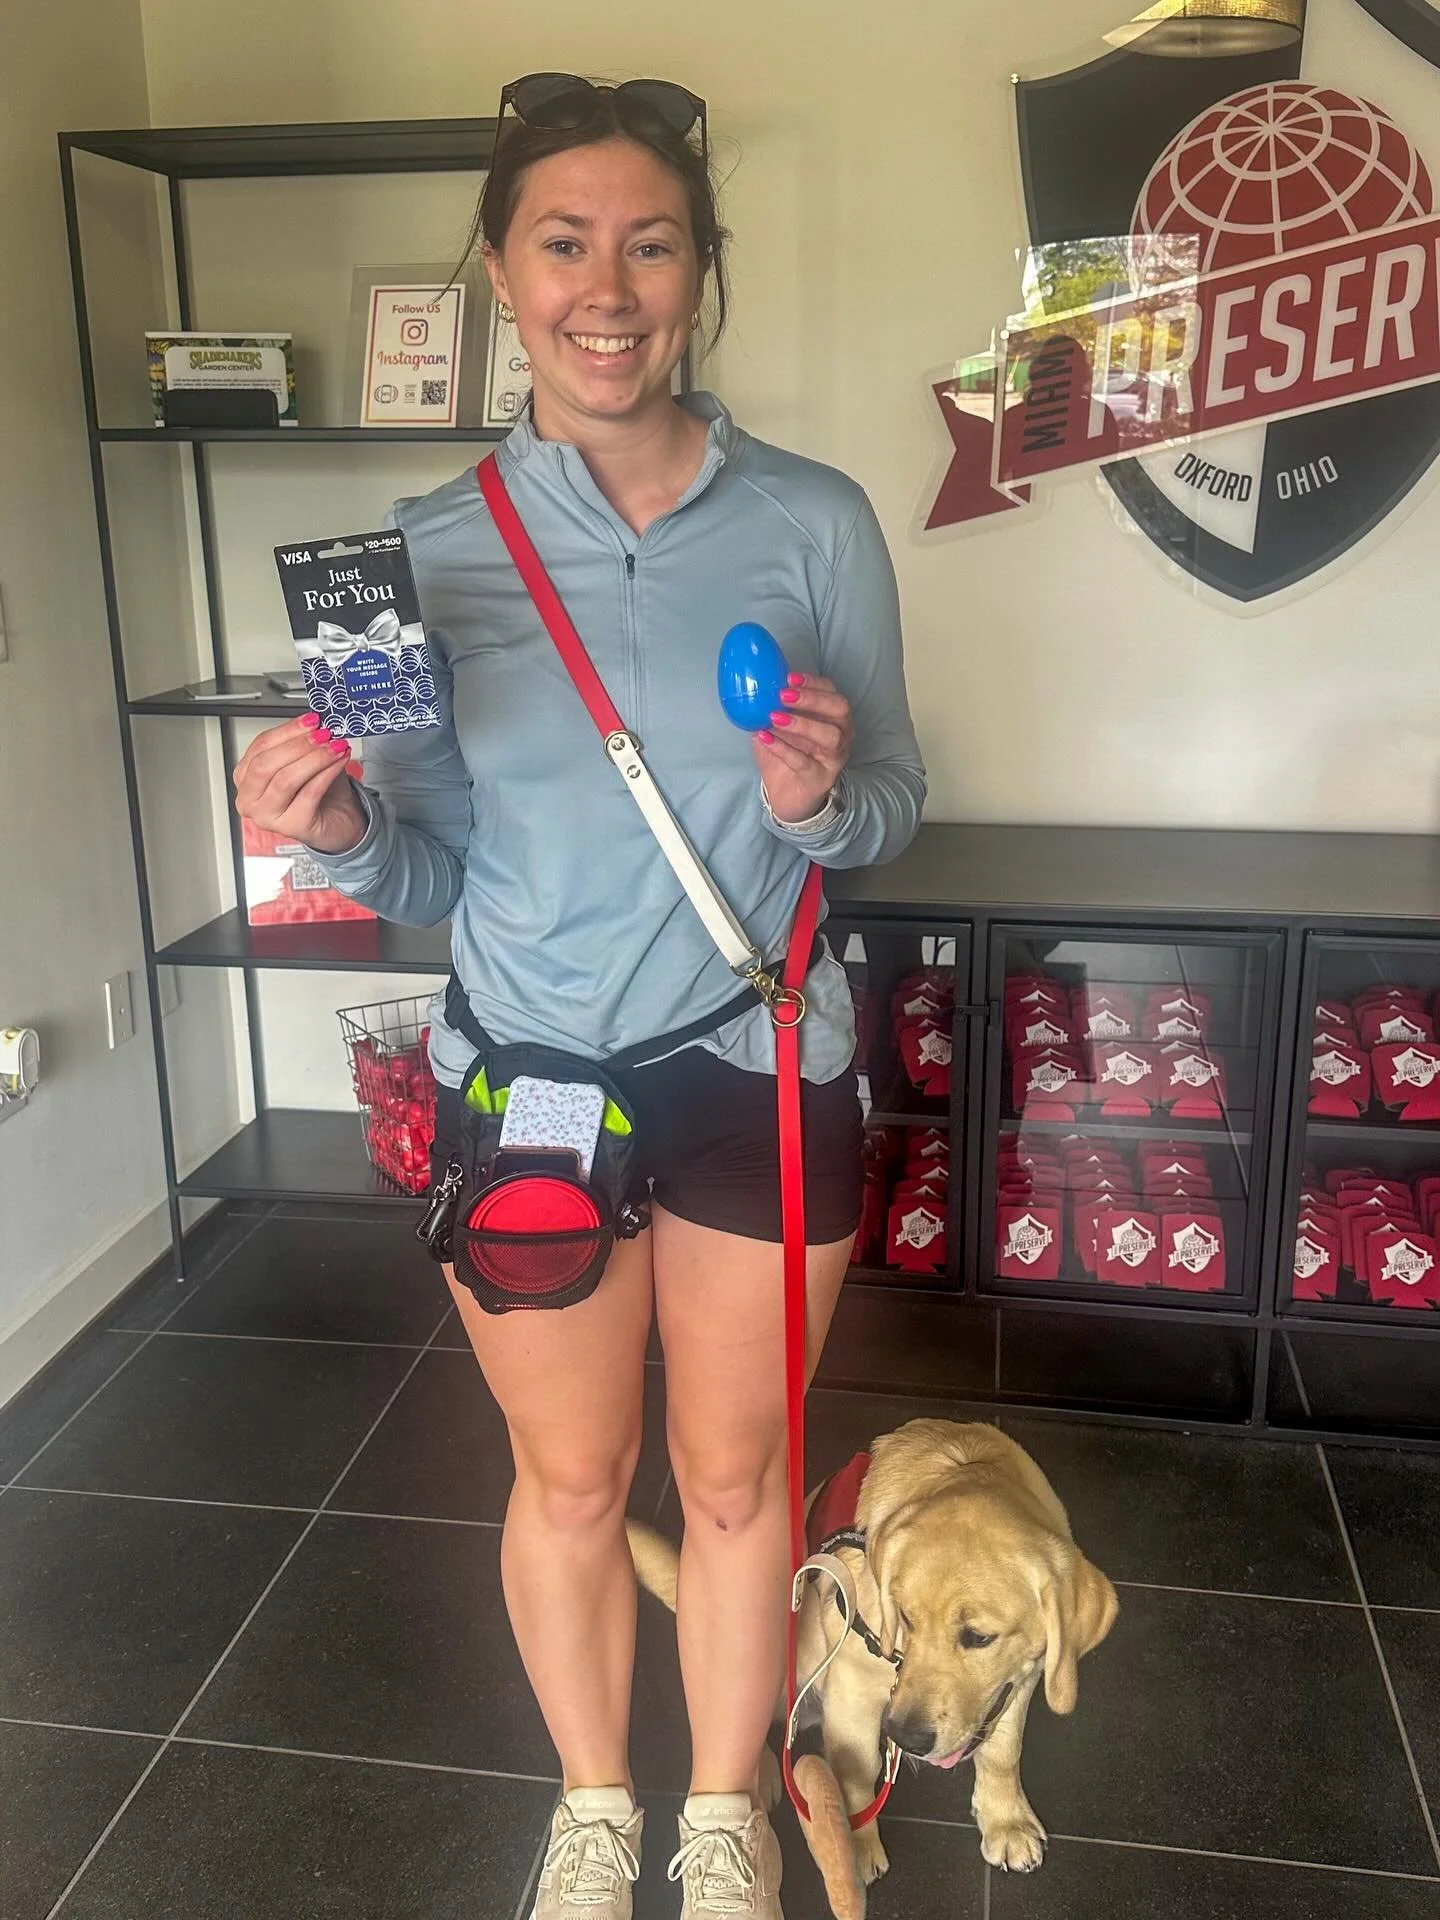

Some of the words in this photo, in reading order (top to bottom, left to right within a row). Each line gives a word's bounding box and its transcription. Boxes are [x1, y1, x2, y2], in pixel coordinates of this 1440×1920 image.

[392, 304, 425, 314] Follow
[426, 304, 441, 314] US
[1087, 236, 1440, 439] PRESER
[377, 350, 448, 371] Instagram
[509, 357, 531, 372] Go
[1023, 336, 1074, 452] MIAMI
[1174, 453, 1252, 502] OXFORD
[1276, 455, 1339, 500] OHIO
[281, 550, 312, 566] VISA
[328, 566, 363, 587] Just
[303, 588, 346, 611] For
[347, 583, 396, 604] You
[351, 684, 368, 692] LIFT
[371, 681, 391, 690] HERE
[1403, 1063, 1436, 1076] PRESERVE
[1014, 1235, 1047, 1250] PRESERVE
[1119, 1240, 1150, 1252] PRESERVE
[1180, 1245, 1213, 1258] PRESERVE
[1393, 1260, 1427, 1272] PRESERVE
